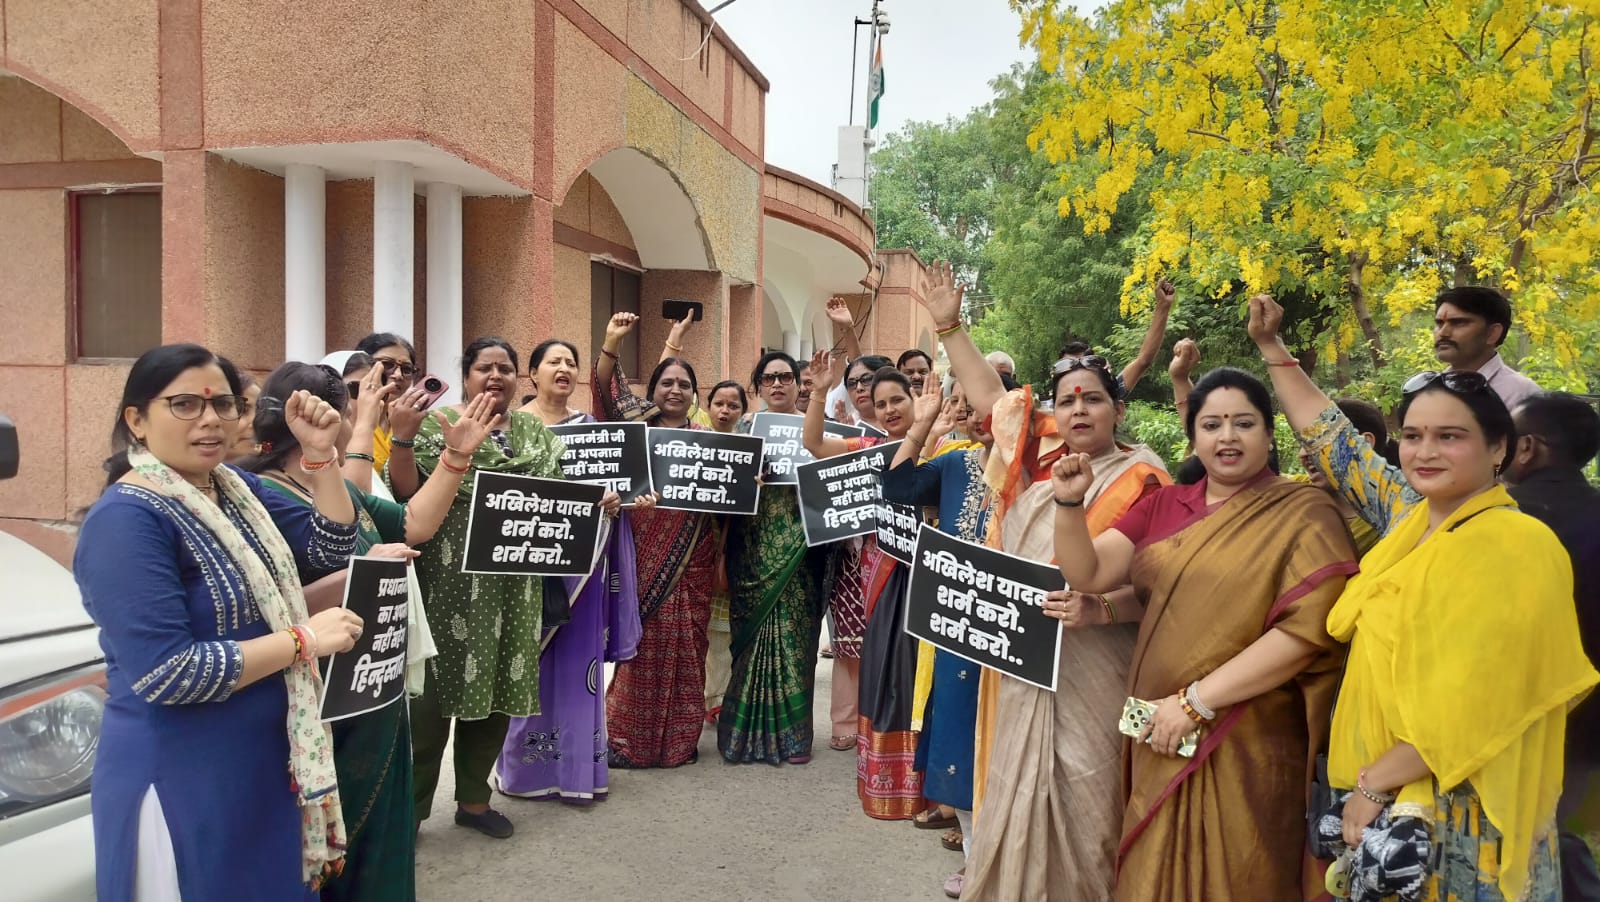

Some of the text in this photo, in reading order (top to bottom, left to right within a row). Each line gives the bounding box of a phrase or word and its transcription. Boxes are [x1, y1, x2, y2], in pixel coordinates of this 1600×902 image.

[610, 429, 625, 443] जी
[769, 424, 799, 438] सपा
[578, 447, 622, 459] अपमान
[654, 440, 754, 464] अखिलेश यादव
[562, 460, 619, 476] नहीं सहेगा
[669, 461, 738, 484] शर्म करो.
[817, 455, 869, 480] प्रधानमंत्री
[869, 452, 885, 467] जी
[662, 482, 736, 505] शर्म करो..
[826, 480, 842, 492] का
[485, 489, 594, 517] अखिलेश यादव
[831, 490, 853, 506] नहीं
[501, 515, 575, 540] शर्म करो.
[492, 541, 572, 565] शर्म करो..
[922, 550, 995, 592] अखिलेश
[377, 605, 395, 625] का
[937, 584, 1026, 634] शर्म करो.
[372, 625, 395, 653] नहीं
[929, 612, 1024, 666] शर्म करो..
